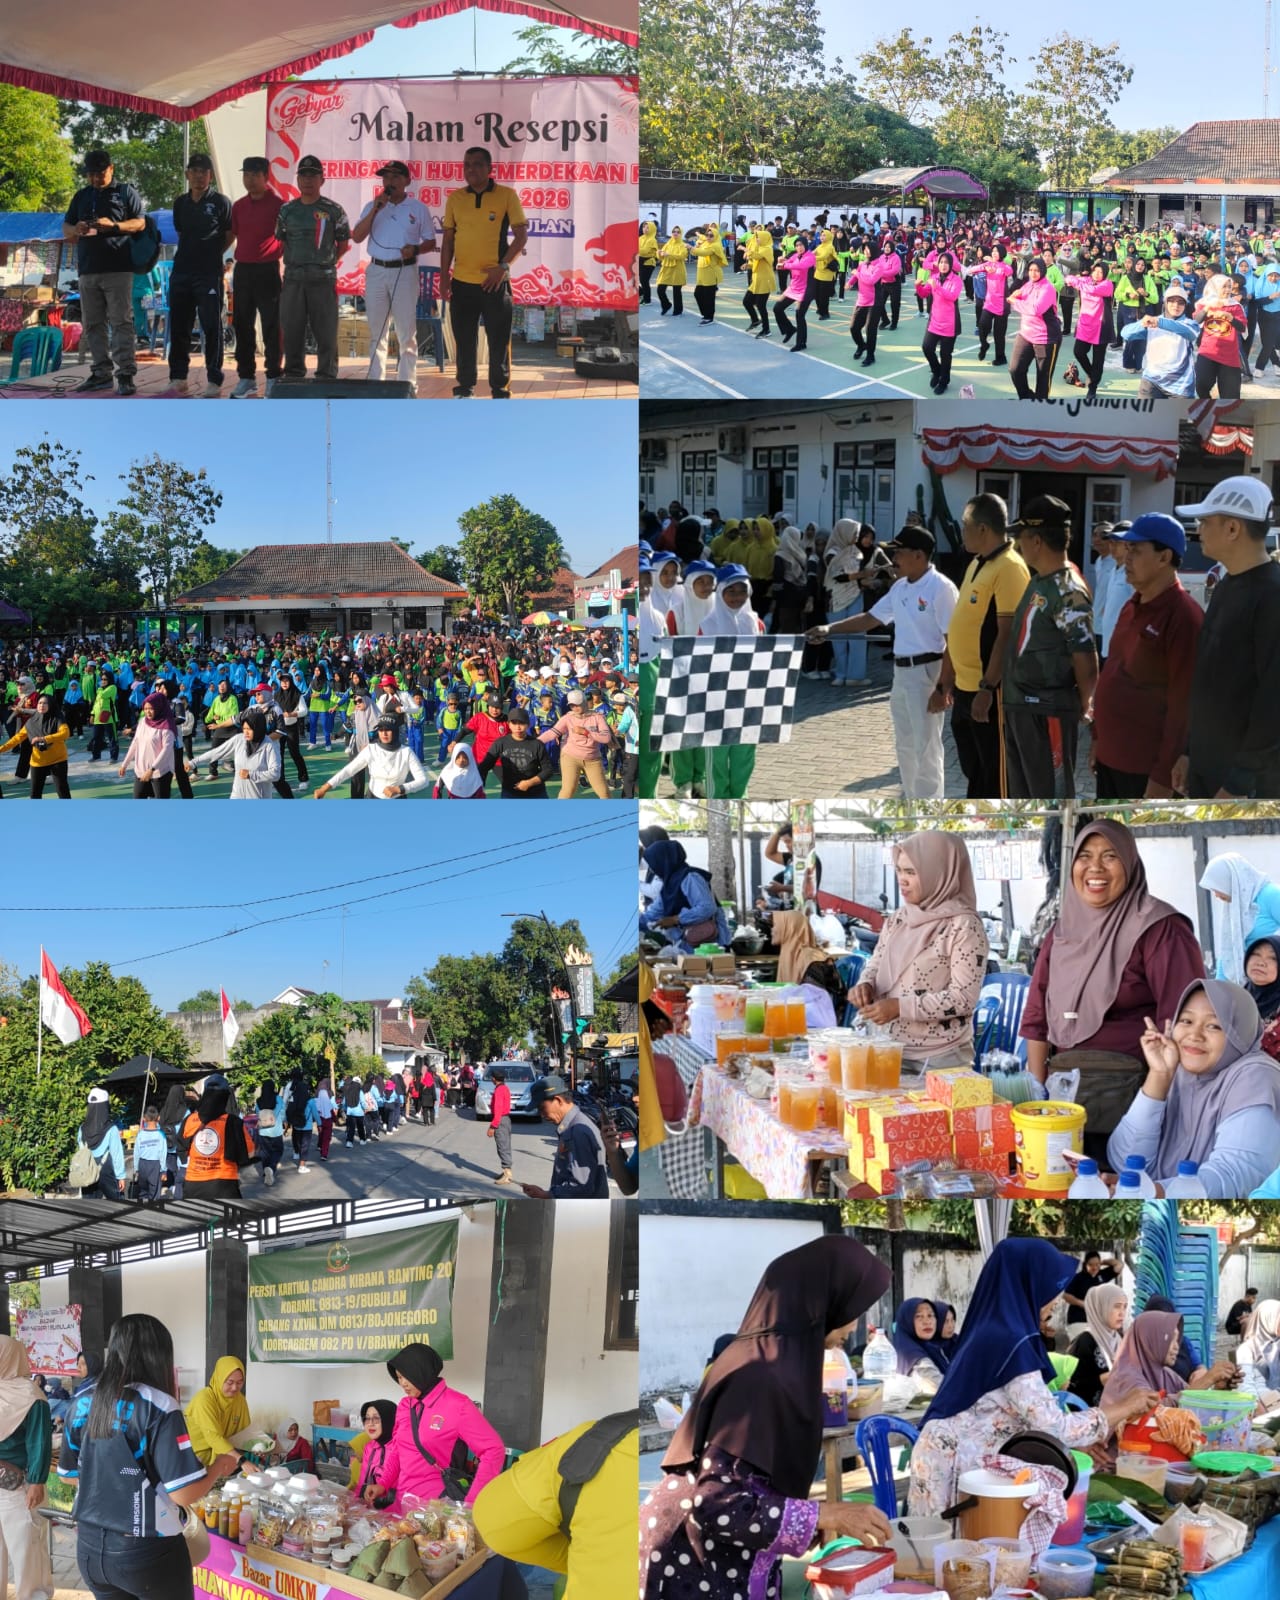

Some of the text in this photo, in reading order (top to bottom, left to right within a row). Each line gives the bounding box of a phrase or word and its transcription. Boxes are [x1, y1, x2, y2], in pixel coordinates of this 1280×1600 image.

[279, 93, 345, 127] Gebyar
[349, 106, 608, 151] Malam Resepsi
[426, 160, 464, 181] HUT
[489, 162, 626, 184] EMERDEKAAN
[418, 186, 442, 208] 81
[520, 187, 571, 210] 2026
[249, 1261, 453, 1298] PERSIT KARTIKA CANDRA KIRANA RANTING 20
[281, 1289, 407, 1314] KORAMIL 0813-19/BUBULAN
[258, 1319, 290, 1332] CABANG
[319, 1316, 337, 1330] DIM
[339, 1308, 438, 1330] 0813/BOJONEGORO
[262, 1337, 318, 1351] KOORCABREM
[320, 1336, 339, 1350] 082
[341, 1336, 354, 1350] PD
[241, 1556, 317, 1600] Bazar UMKM
